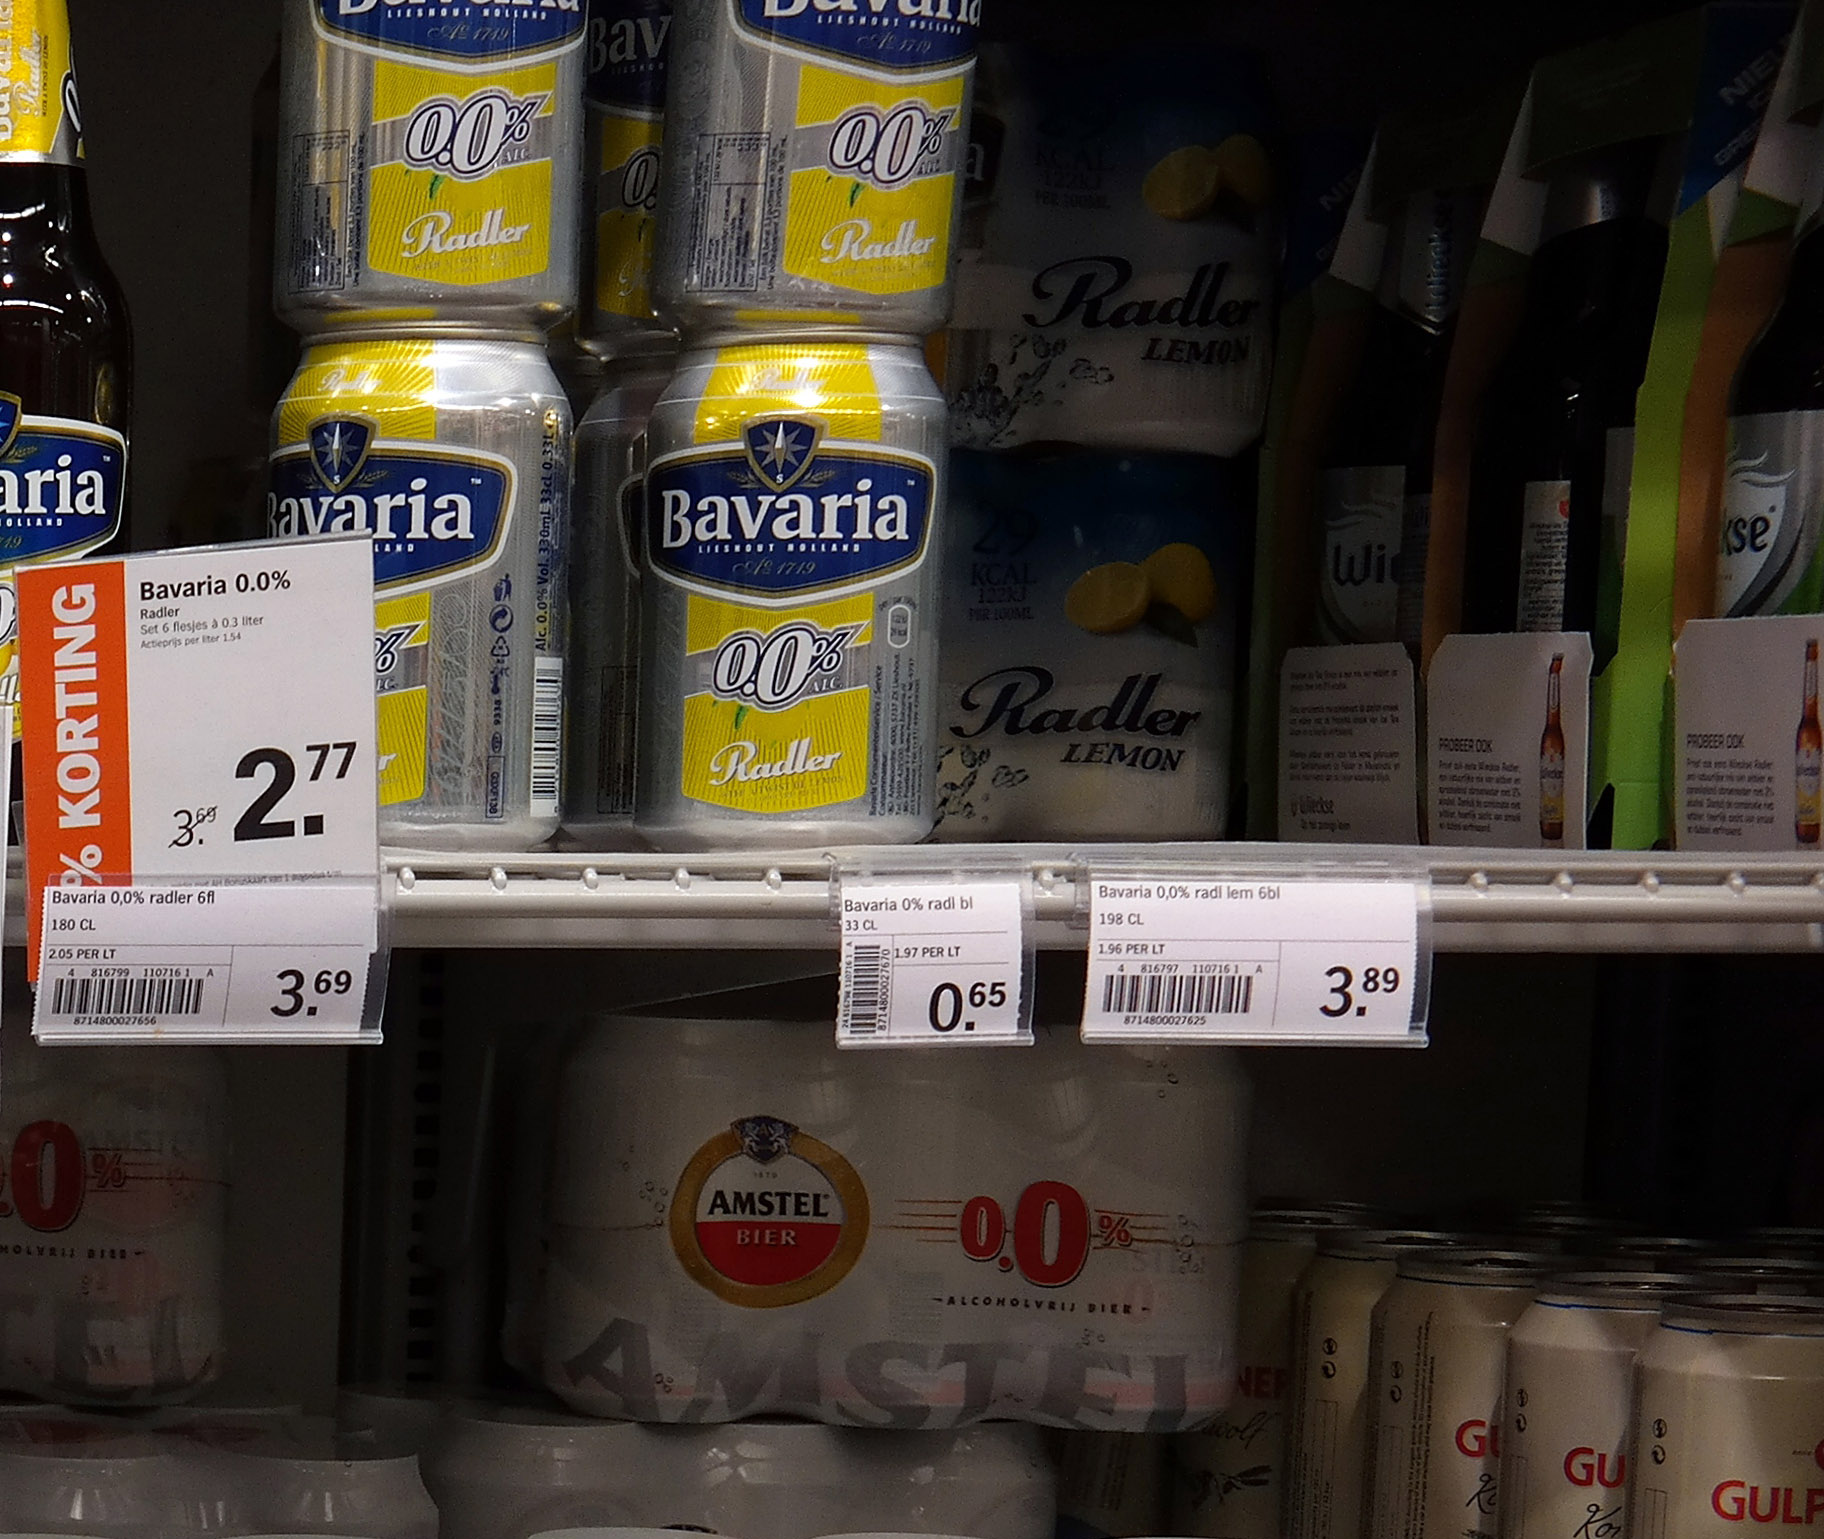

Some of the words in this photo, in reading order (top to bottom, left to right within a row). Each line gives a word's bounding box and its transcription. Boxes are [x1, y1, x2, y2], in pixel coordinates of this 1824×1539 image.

[662, 479, 910, 550] Bavaria
[140, 574, 227, 601] Bavaria
[235, 570, 291, 594] 0.0%
[140, 606, 180, 620] Radler
[140, 624, 159, 636] Set
[162, 623, 170, 634] 6
[172, 619, 208, 636] flesjes
[222, 616, 239, 630] 0.3
[241, 614, 264, 628] liter
[53, 583, 102, 829] KORTING
[949, 665, 1202, 738] Radler
[708, 736, 843, 786] Radler
[1060, 742, 1185, 772] LEMON
[233, 741, 357, 843] 2.77
[1098, 884, 1151, 900] Bavaria
[1155, 885, 1190, 902] 0,0%
[1194, 884, 1221, 900] radl
[1225, 885, 1251, 899] lem
[1258, 886, 1280, 899] 6bl
[270, 969, 352, 1017] 3.69
[928, 982, 1006, 1033] 0.65
[1318, 965, 1399, 1018] 3.89
[707, 1188, 830, 1218] AMSTEL
[960, 1180, 1134, 1288] 0.0%
